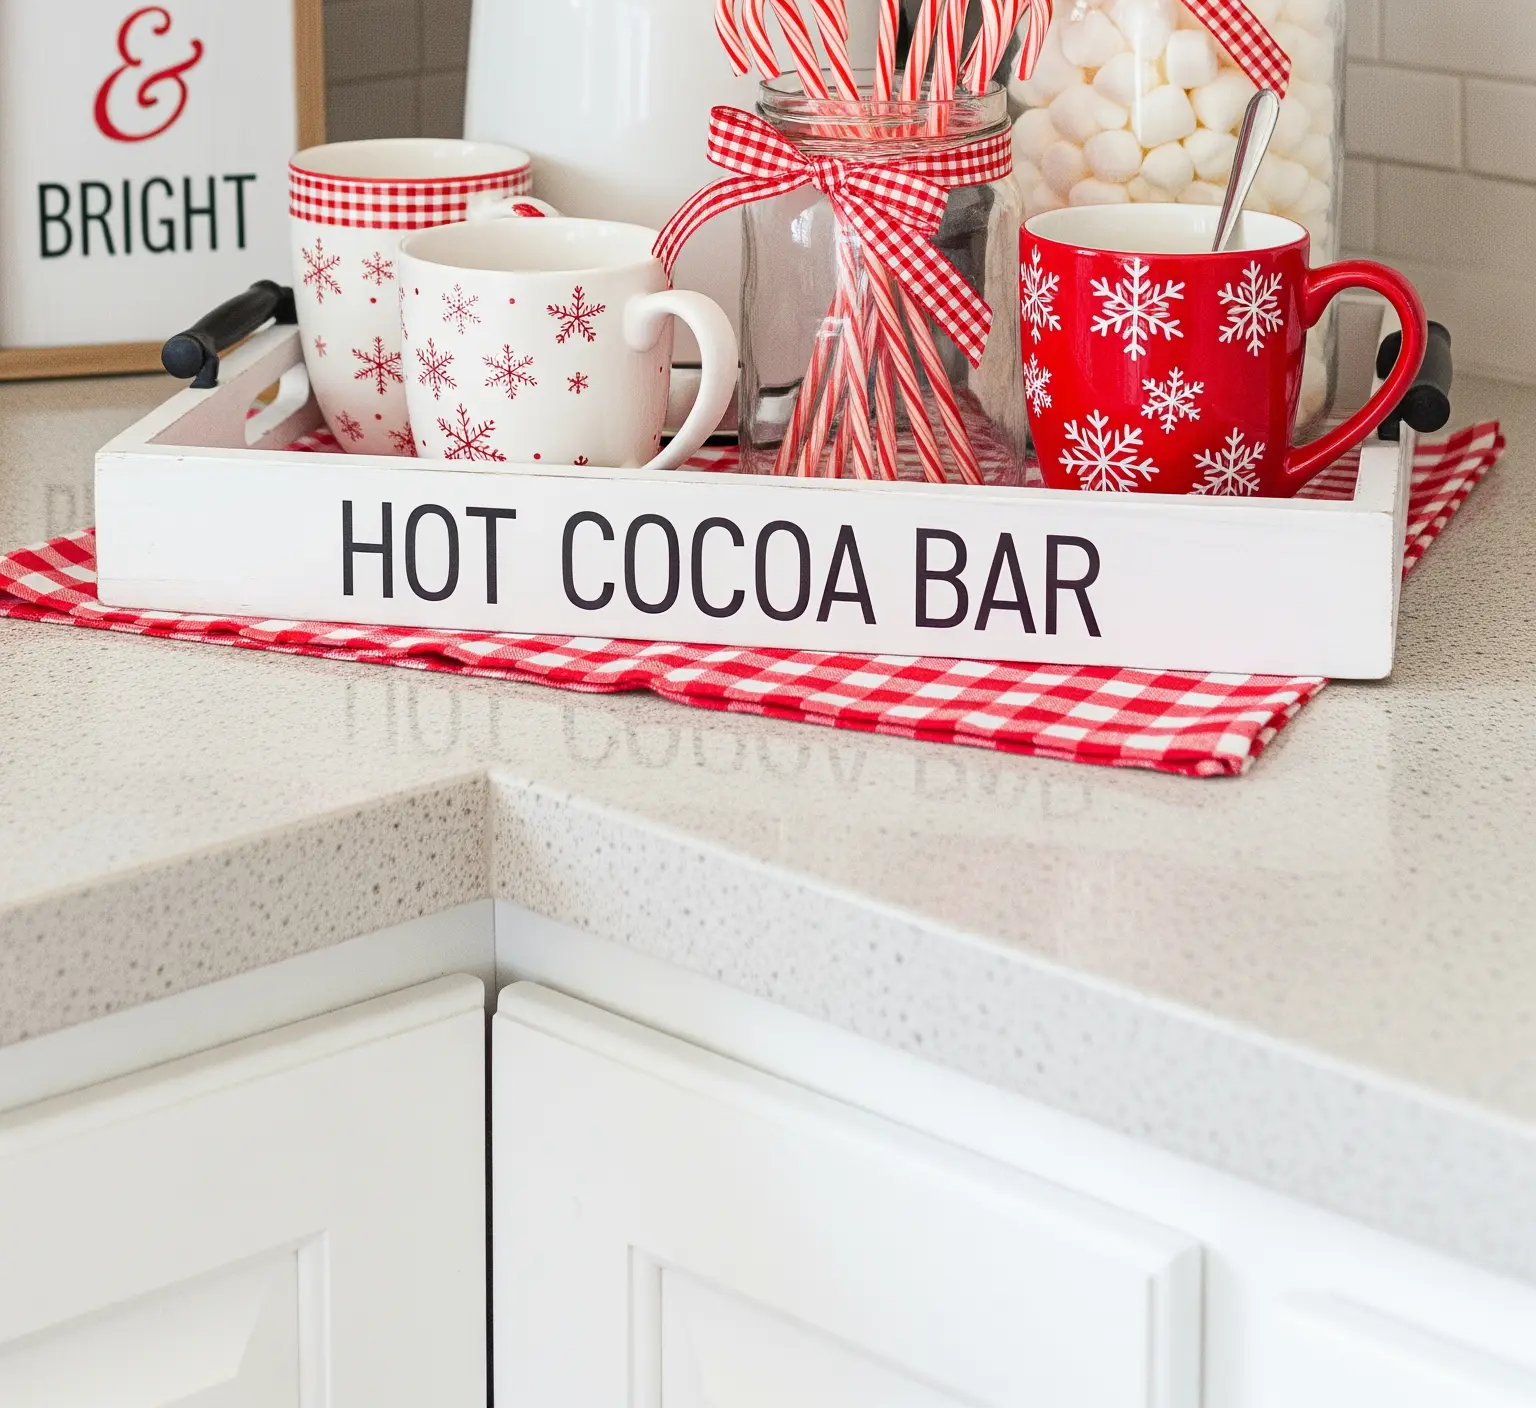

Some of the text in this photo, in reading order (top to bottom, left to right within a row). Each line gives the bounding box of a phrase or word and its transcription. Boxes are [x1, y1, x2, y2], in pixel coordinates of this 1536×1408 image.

[93, 6, 205, 144] &
[38, 173, 257, 259] BRIGHT
[342, 499, 1102, 638] HOT COCOA BAR
